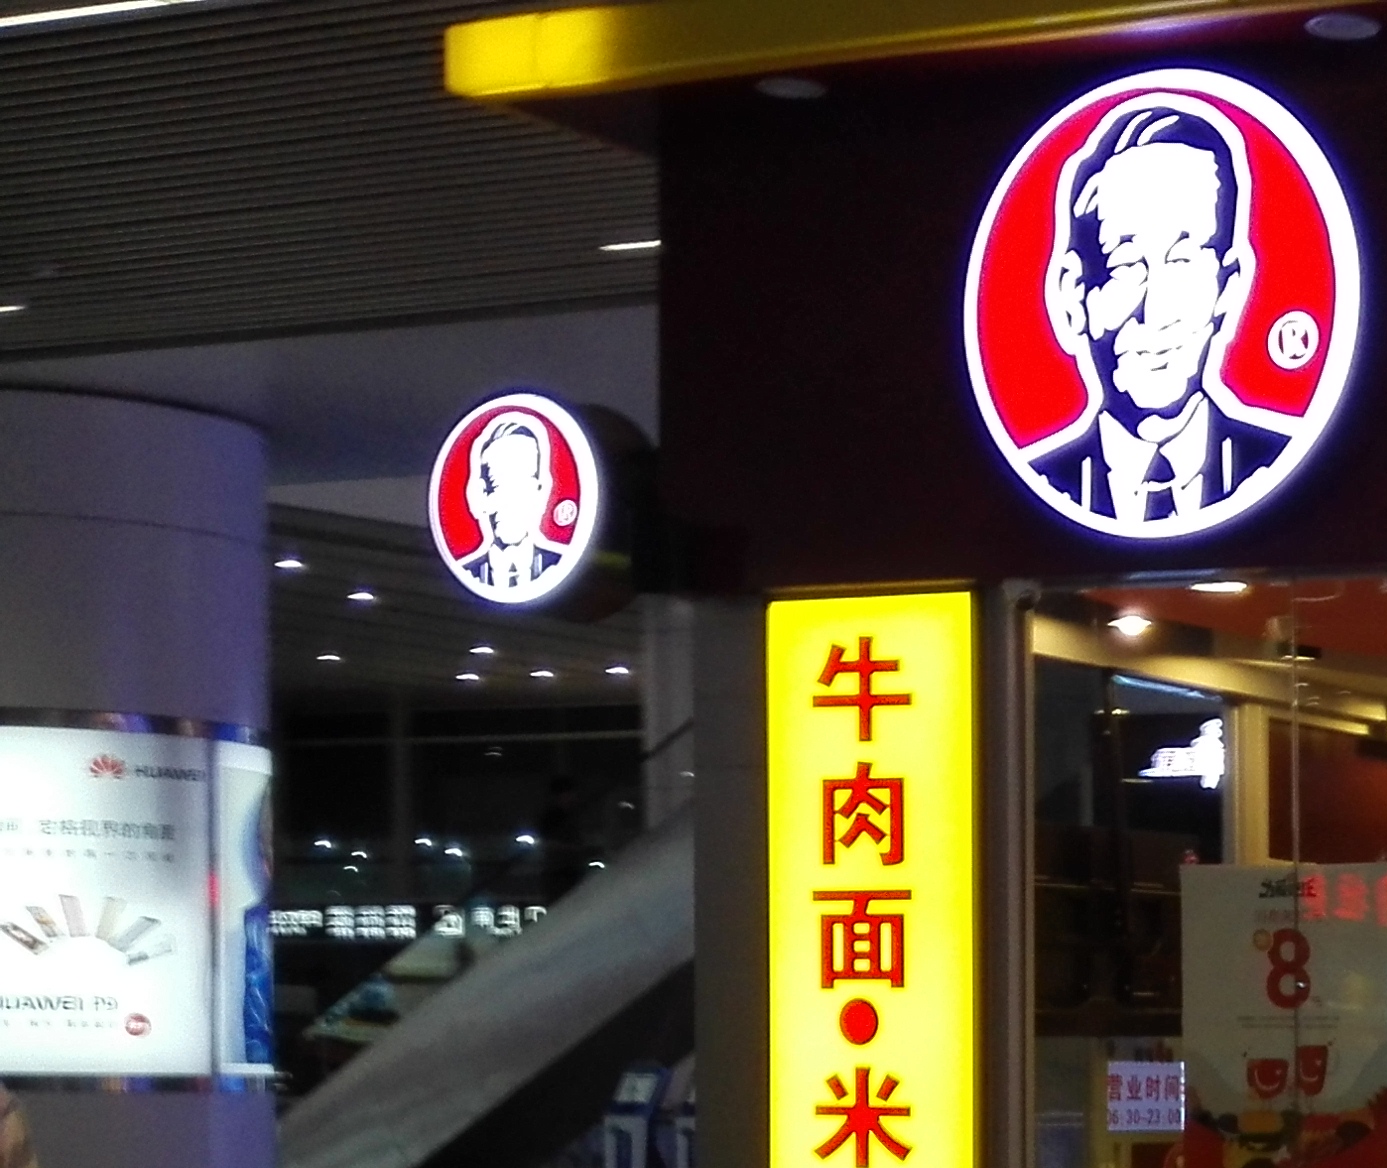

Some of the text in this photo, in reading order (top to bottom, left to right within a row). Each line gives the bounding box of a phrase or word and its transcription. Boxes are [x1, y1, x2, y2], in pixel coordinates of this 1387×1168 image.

[1267, 928, 1311, 1009] 8
[0, 996, 84, 1011] UAWEI
[1107, 1074, 1180, 1102] 营业时间
